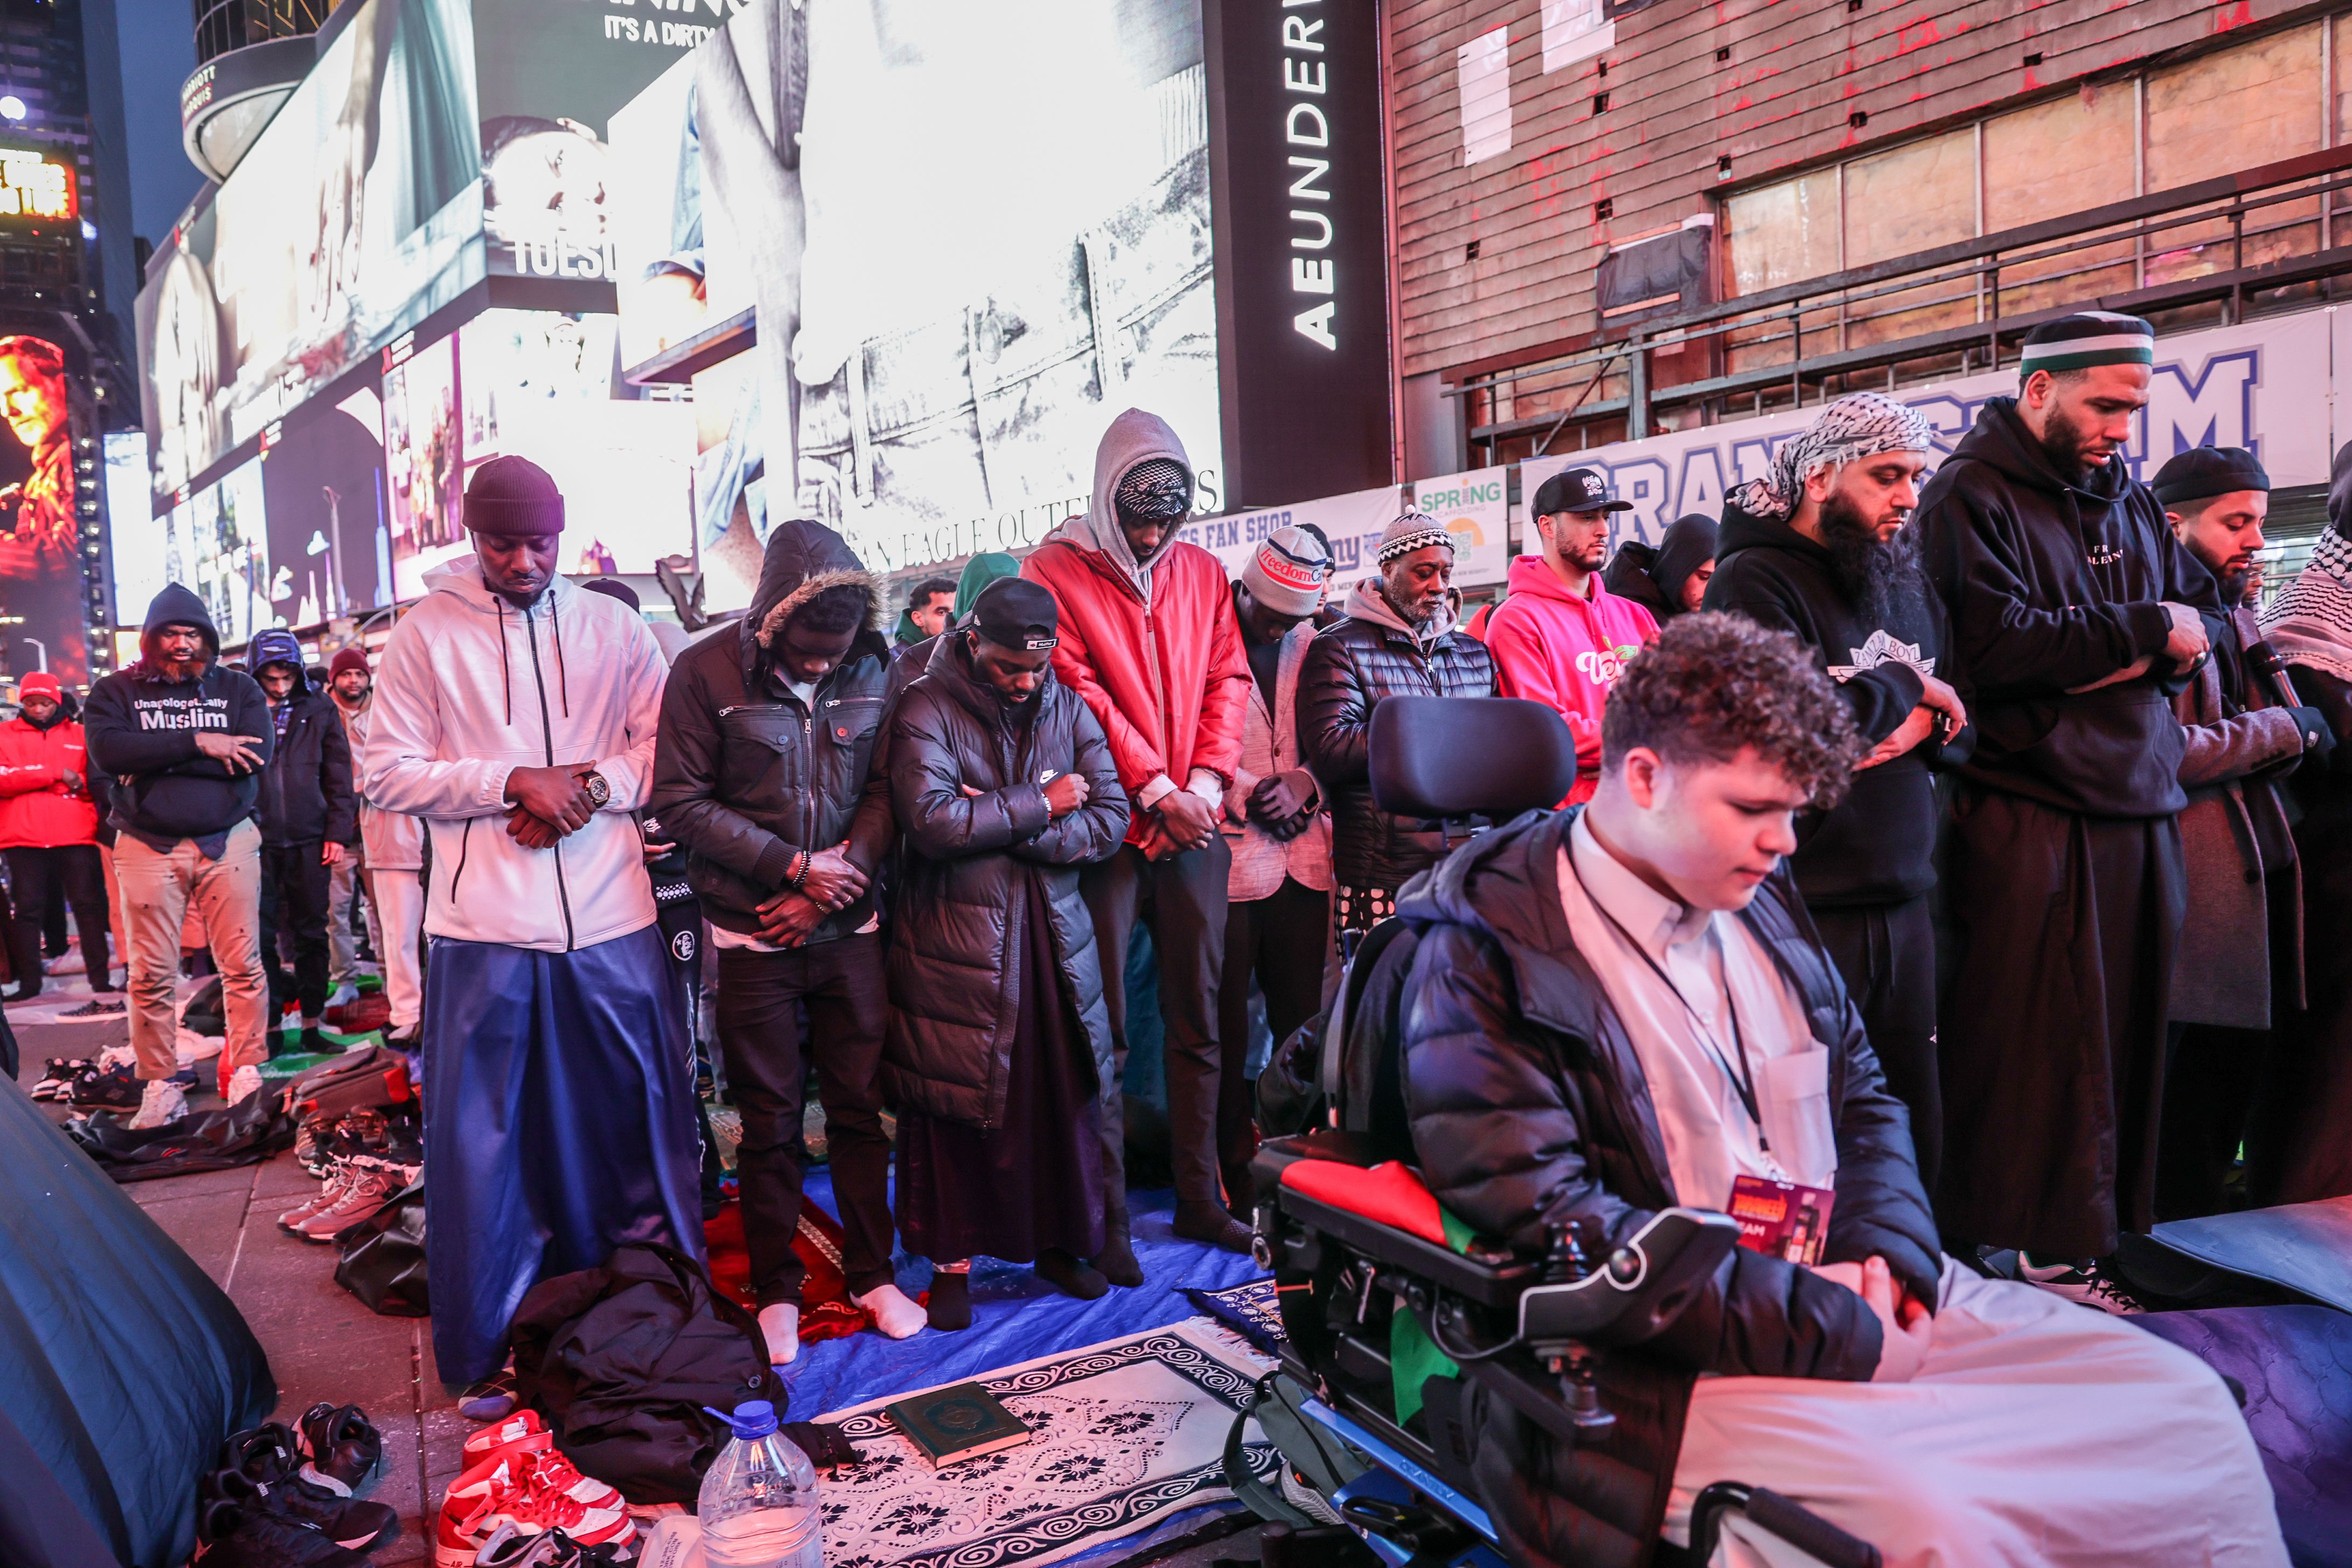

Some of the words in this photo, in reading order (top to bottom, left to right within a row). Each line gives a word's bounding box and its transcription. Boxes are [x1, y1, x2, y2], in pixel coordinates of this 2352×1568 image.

[604, 15, 640, 41] IT'S
[643, 20, 659, 43] A
[902, 517, 986, 567] EAGLE
[1206, 520, 1239, 549] FAN
[1261, 548, 1322, 583] FreedomCa
[1888, 640, 1919, 661] BOYZ
[134, 697, 228, 710] Unapologetally
[140, 708, 228, 730] Muslim
